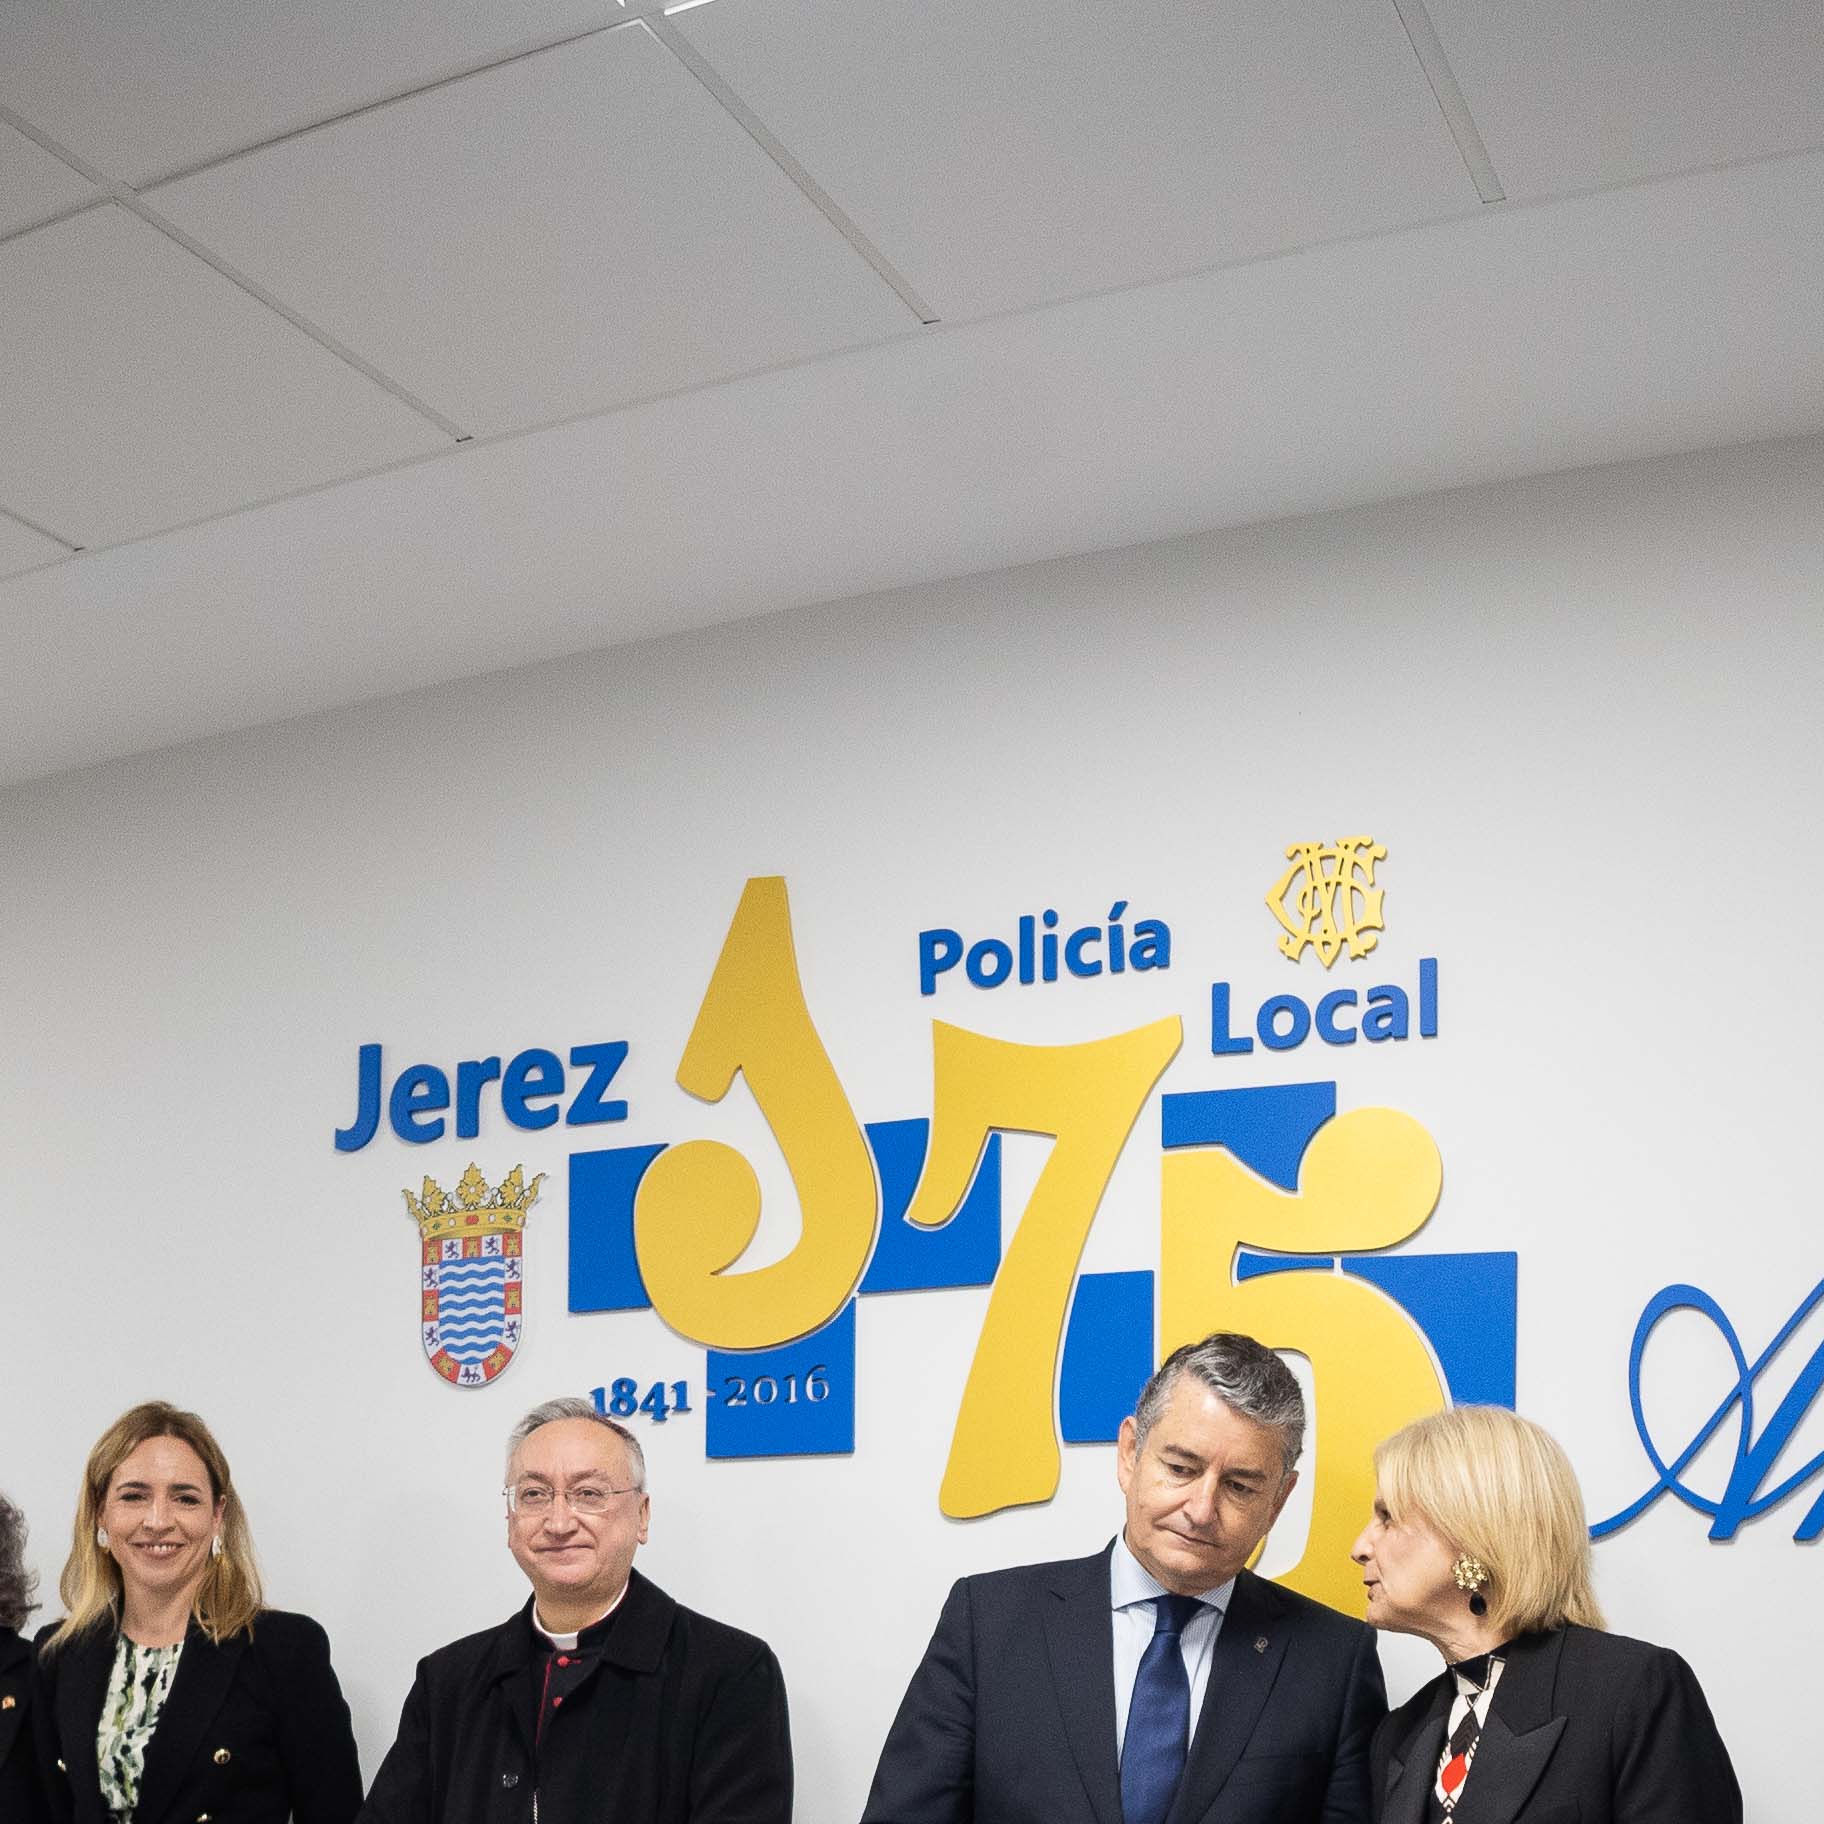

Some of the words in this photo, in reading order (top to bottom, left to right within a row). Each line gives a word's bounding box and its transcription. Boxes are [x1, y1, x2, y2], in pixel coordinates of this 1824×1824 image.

[918, 900, 1170, 994] Policía
[1210, 958, 1438, 1055] Local
[334, 1041, 629, 1152] Jerez
